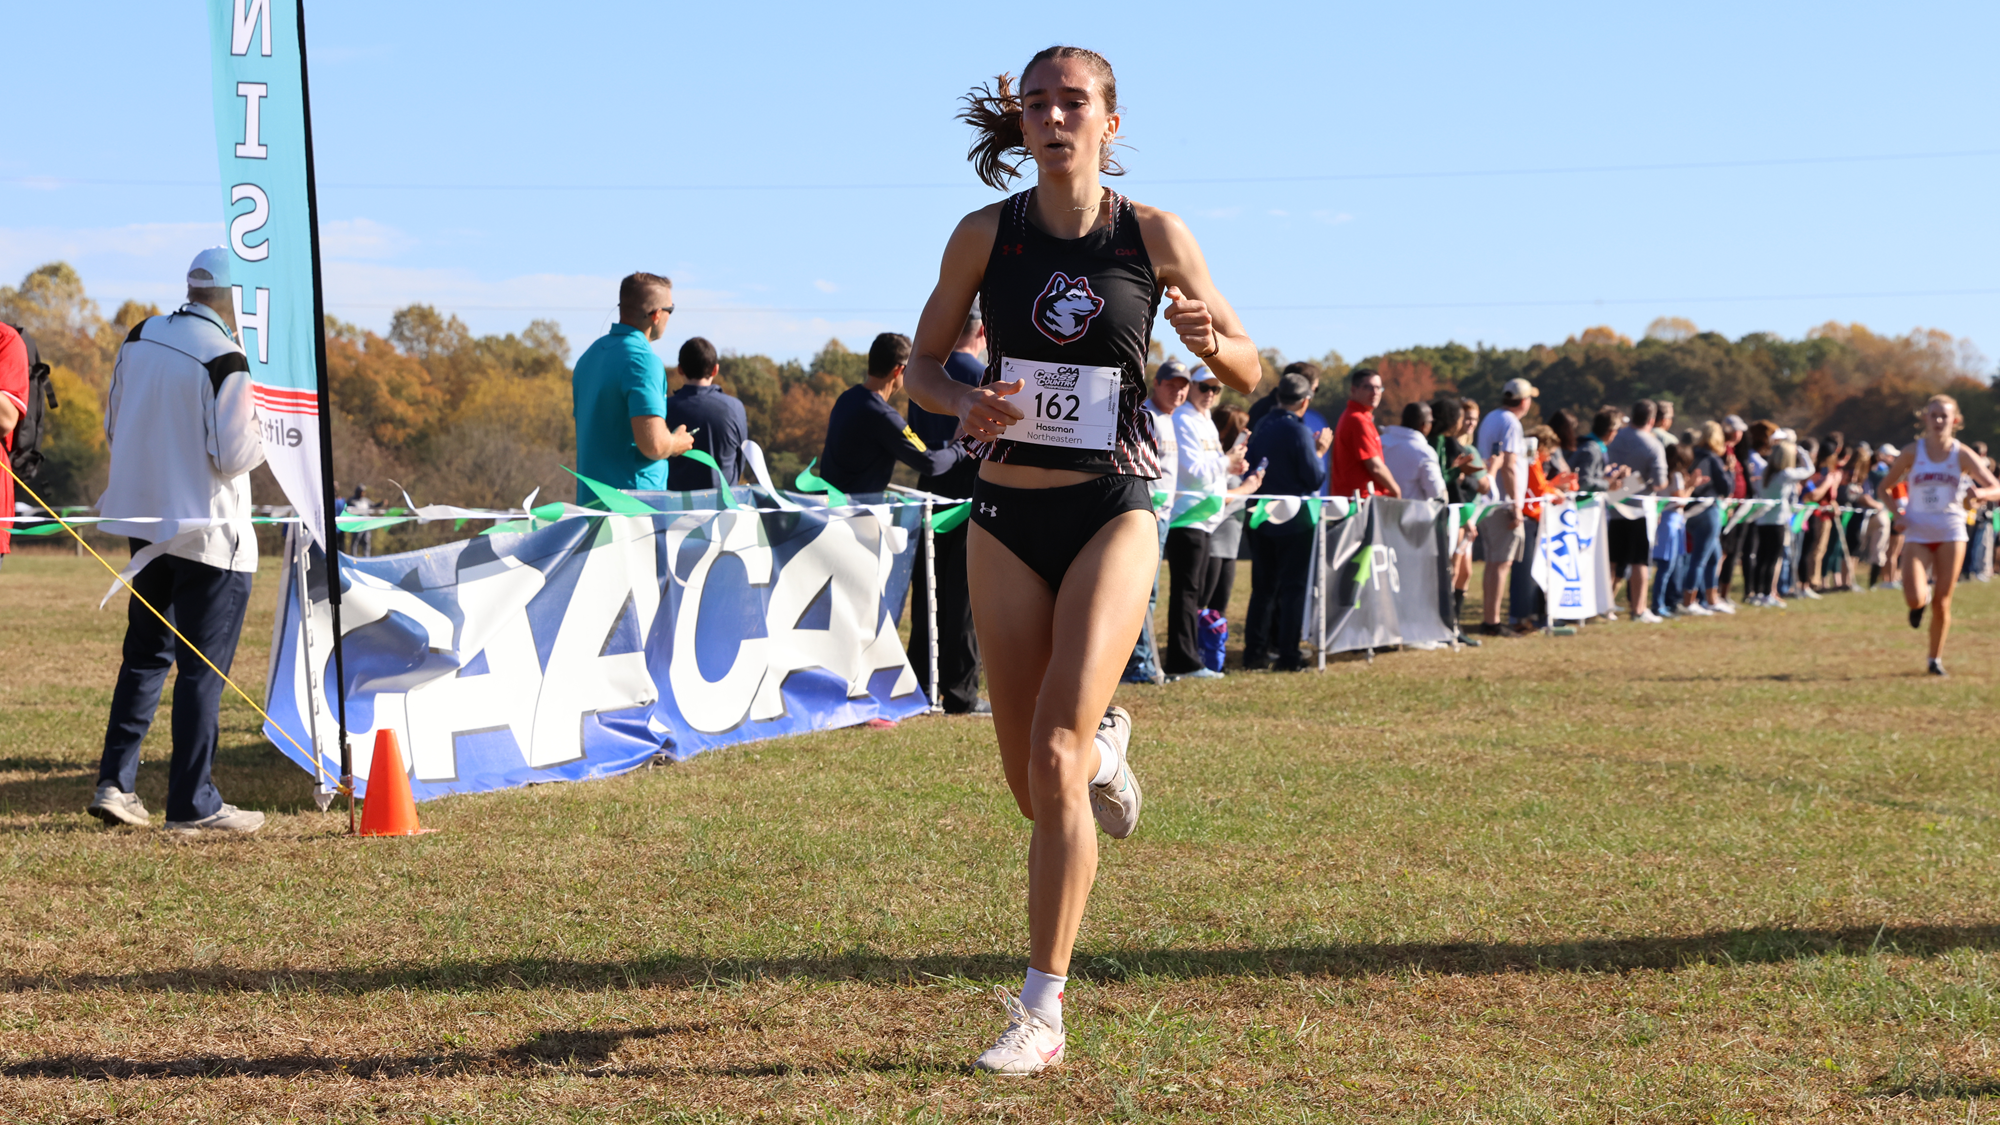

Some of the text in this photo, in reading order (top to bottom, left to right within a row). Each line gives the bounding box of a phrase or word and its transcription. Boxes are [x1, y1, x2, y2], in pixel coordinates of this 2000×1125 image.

[1115, 248, 1138, 256] CAA
[1033, 368, 1078, 381] CROSS
[1057, 366, 1080, 375] CAA
[1036, 378, 1076, 387] COUNTRY
[1035, 391, 1080, 421] 162
[1036, 422, 1074, 433] Hassman
[1027, 431, 1083, 444] Northeastern
